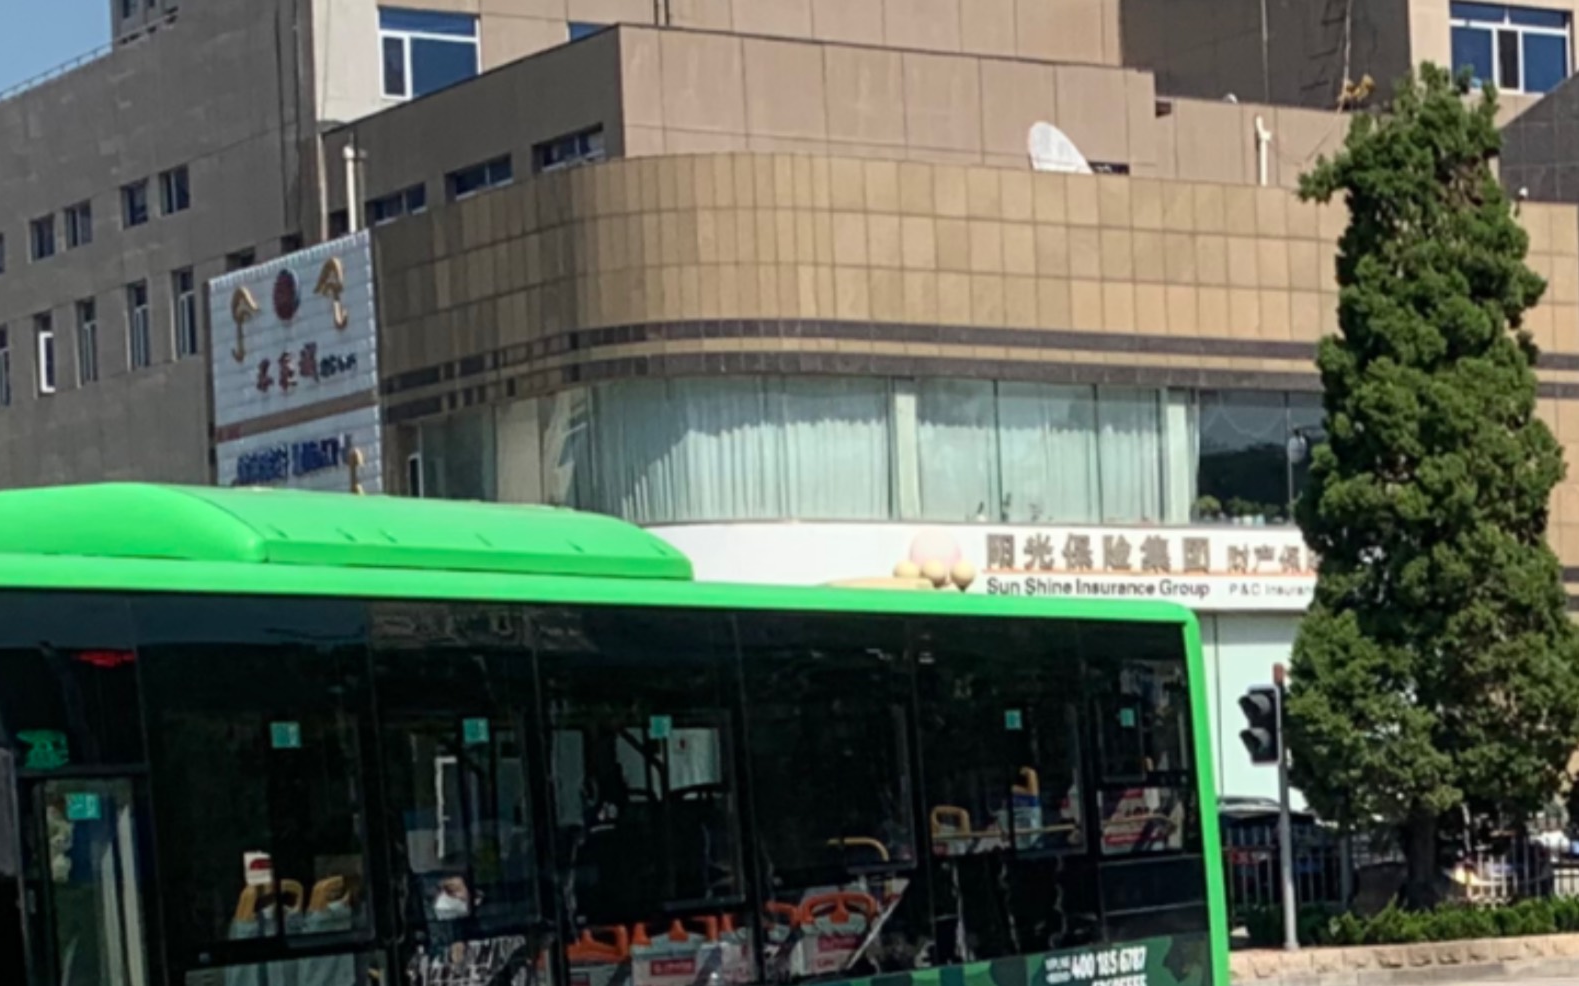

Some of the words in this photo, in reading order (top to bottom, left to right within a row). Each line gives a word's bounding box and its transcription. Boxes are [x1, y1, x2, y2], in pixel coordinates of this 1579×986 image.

[986, 534, 1210, 573] 阳光保险集团
[986, 577, 1020, 595] Sun
[1025, 577, 1073, 596] Shine
[1077, 580, 1156, 597] Insurance
[1160, 581, 1210, 599] Group
[1073, 953, 1095, 980] 400
